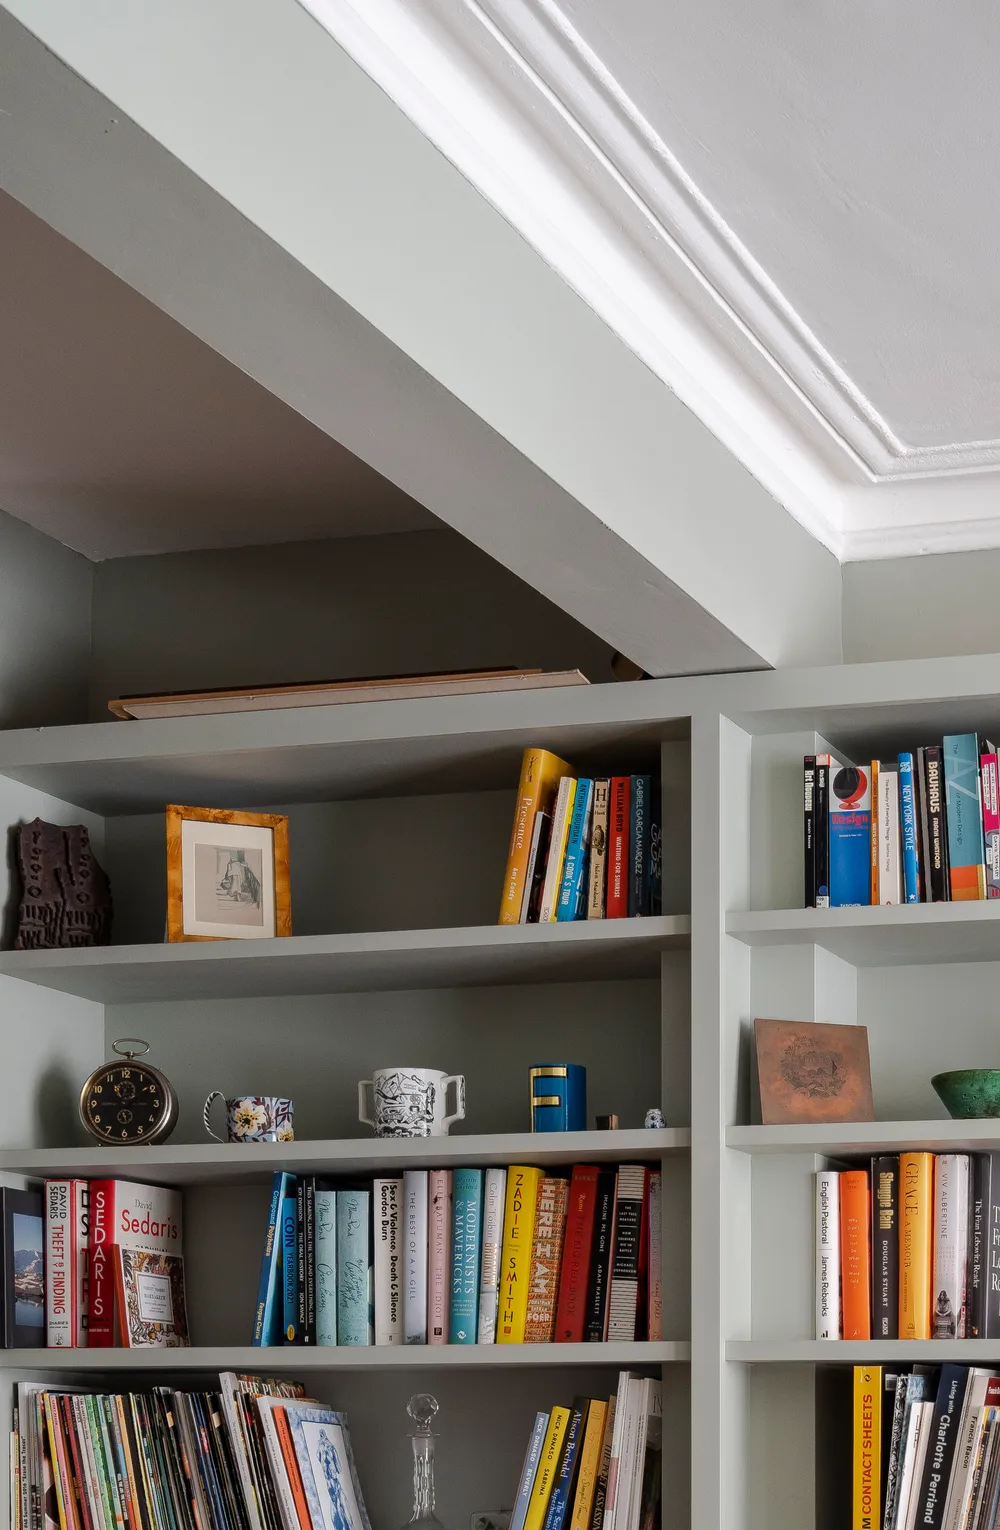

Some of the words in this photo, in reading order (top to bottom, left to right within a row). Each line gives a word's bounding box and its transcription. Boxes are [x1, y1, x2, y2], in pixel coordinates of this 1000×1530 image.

[575, 784, 587, 813] ANTHONY
[616, 782, 624, 812] WILLIAM
[903, 785, 911, 800] NEW
[928, 762, 940, 813] BAUHAUS
[516, 797, 533, 849] Presence
[616, 813, 624, 832] BOYD
[904, 801, 913, 826] YORK
[572, 814, 583, 844] BOURDAIN
[905, 828, 914, 851] STYLE
[563, 862, 576, 886] COOK'S
[509, 880, 517, 900] Cuddy
[562, 887, 571, 905] TOUR
[122, 1070, 130, 1078] 12
[91, 1100, 97, 1108] 9
[122, 1129, 127, 1137] 6
[49, 1186, 58, 1219] SEDARIS
[59, 1186, 67, 1219] DAVID
[134, 1199, 152, 1210] David
[381, 1185, 389, 1218] Gordon
[390, 1185, 398, 1200] Sex
[456, 1200, 464, 1208] &
[821, 1181, 829, 1211] English
[880, 1172, 894, 1208] Shuggie
[905, 1162, 919, 1217] GRACE
[511, 1174, 523, 1239] ZADIE
[537, 1182, 556, 1241] HERE
[880, 1210, 894, 1230] Bain
[121, 1209, 178, 1239] Sedaris
[284, 1216, 295, 1248] COIN
[390, 1210, 398, 1253] Violence,
[821, 1211, 829, 1244] Pastoral
[52, 1224, 64, 1259] THEFT
[93, 1192, 106, 1315] SEDARIS
[454, 1214, 464, 1294] MAVERICKS
[465, 1200, 476, 1294] MODERNISTS
[286, 1252, 295, 1287] YEARBOOK
[390, 1256, 398, 1276] Death
[534, 1262, 551, 1294] AM
[821, 1255, 829, 1280] James
[53, 1271, 65, 1314] FINDING
[503, 1257, 518, 1323] SMITH
[821, 1283, 829, 1317] Rebanks
[527, 1313, 550, 1322] FOER
[238, 1380, 261, 1395] THE
[262, 1383, 297, 1398] PLANT
[536, 1417, 544, 1433] NICK
[554, 1414, 562, 1430] NICK
[570, 1410, 582, 1440] Alison
[862, 1394, 873, 1449] SHEETS
[530, 1436, 540, 1462] DRNASO
[547, 1433, 558, 1460] DRNASO
[932, 1414, 951, 1470] Charlotte
[560, 1442, 576, 1478] Bechdel
[523, 1468, 533, 1497] BEVERLY
[538, 1468, 550, 1496] SABRINA
[862, 1451, 872, 1514] CONTACT
[923, 1473, 941, 1524] Perriand
